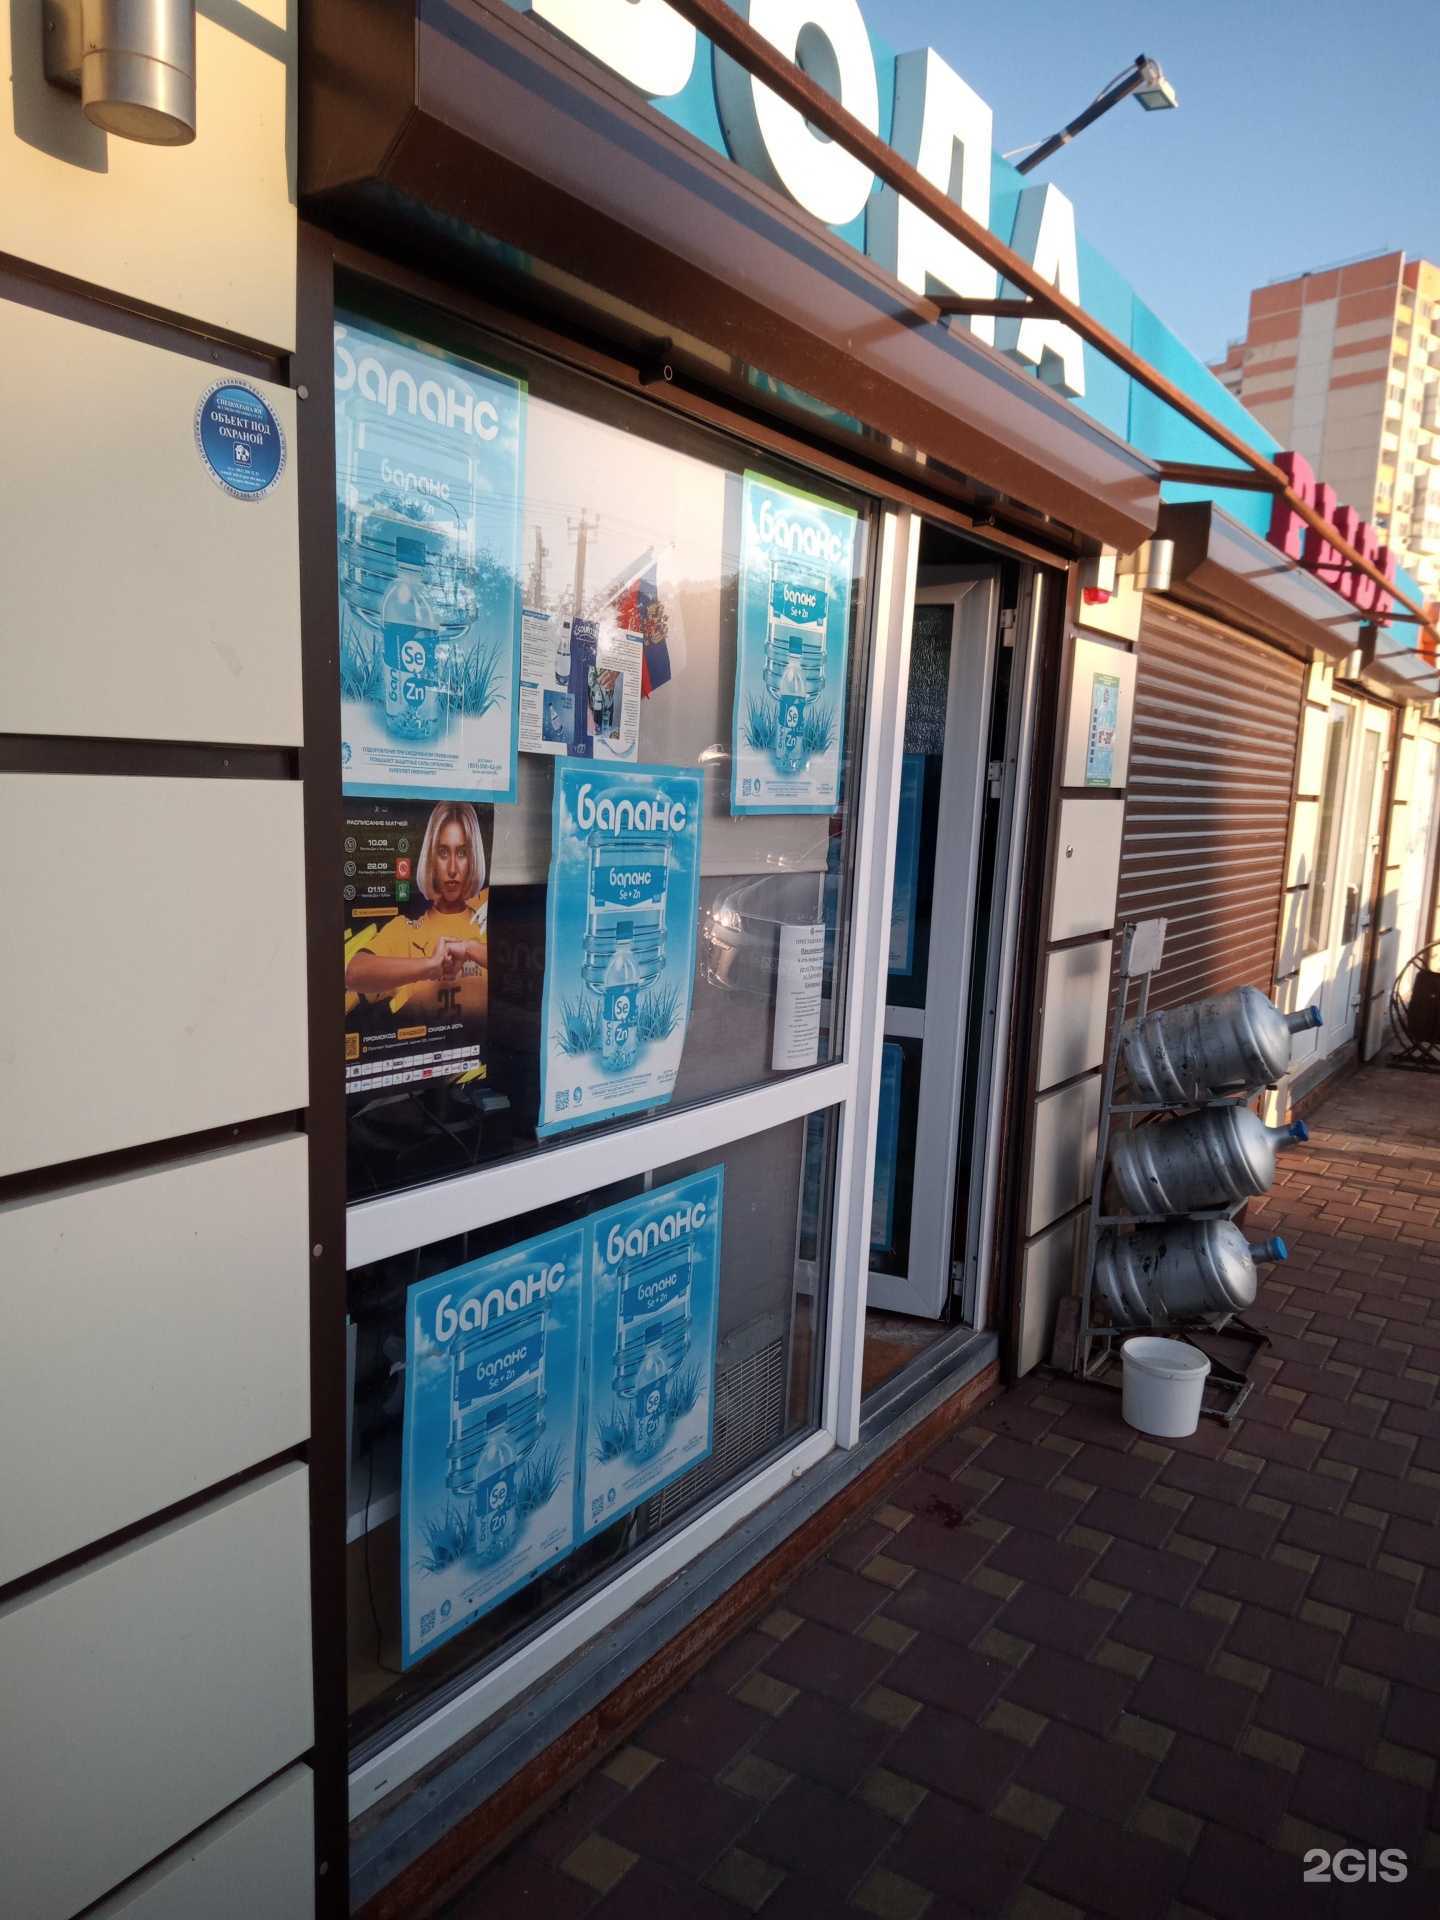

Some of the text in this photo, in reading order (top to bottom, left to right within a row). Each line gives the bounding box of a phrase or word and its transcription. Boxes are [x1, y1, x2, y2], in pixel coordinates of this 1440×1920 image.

[210, 411, 249, 429] ОБЪЕКТ
[251, 420, 271, 436] ПОД
[219, 426, 264, 445] ОХРАНОЙ
[404, 646, 424, 666] Se
[406, 683, 425, 701] Zn
[788, 710, 797, 723] Se
[786, 734, 796, 746] Zn
[619, 890, 629, 900] Se
[633, 889, 641, 899] Zn
[616, 1001, 629, 1014] Se
[616, 1028, 628, 1041] Zn
[489, 1378, 499, 1393] Se
[647, 1395, 659, 1409] Se
[492, 1488, 505, 1504] Se
[492, 1514, 506, 1532] Zn
